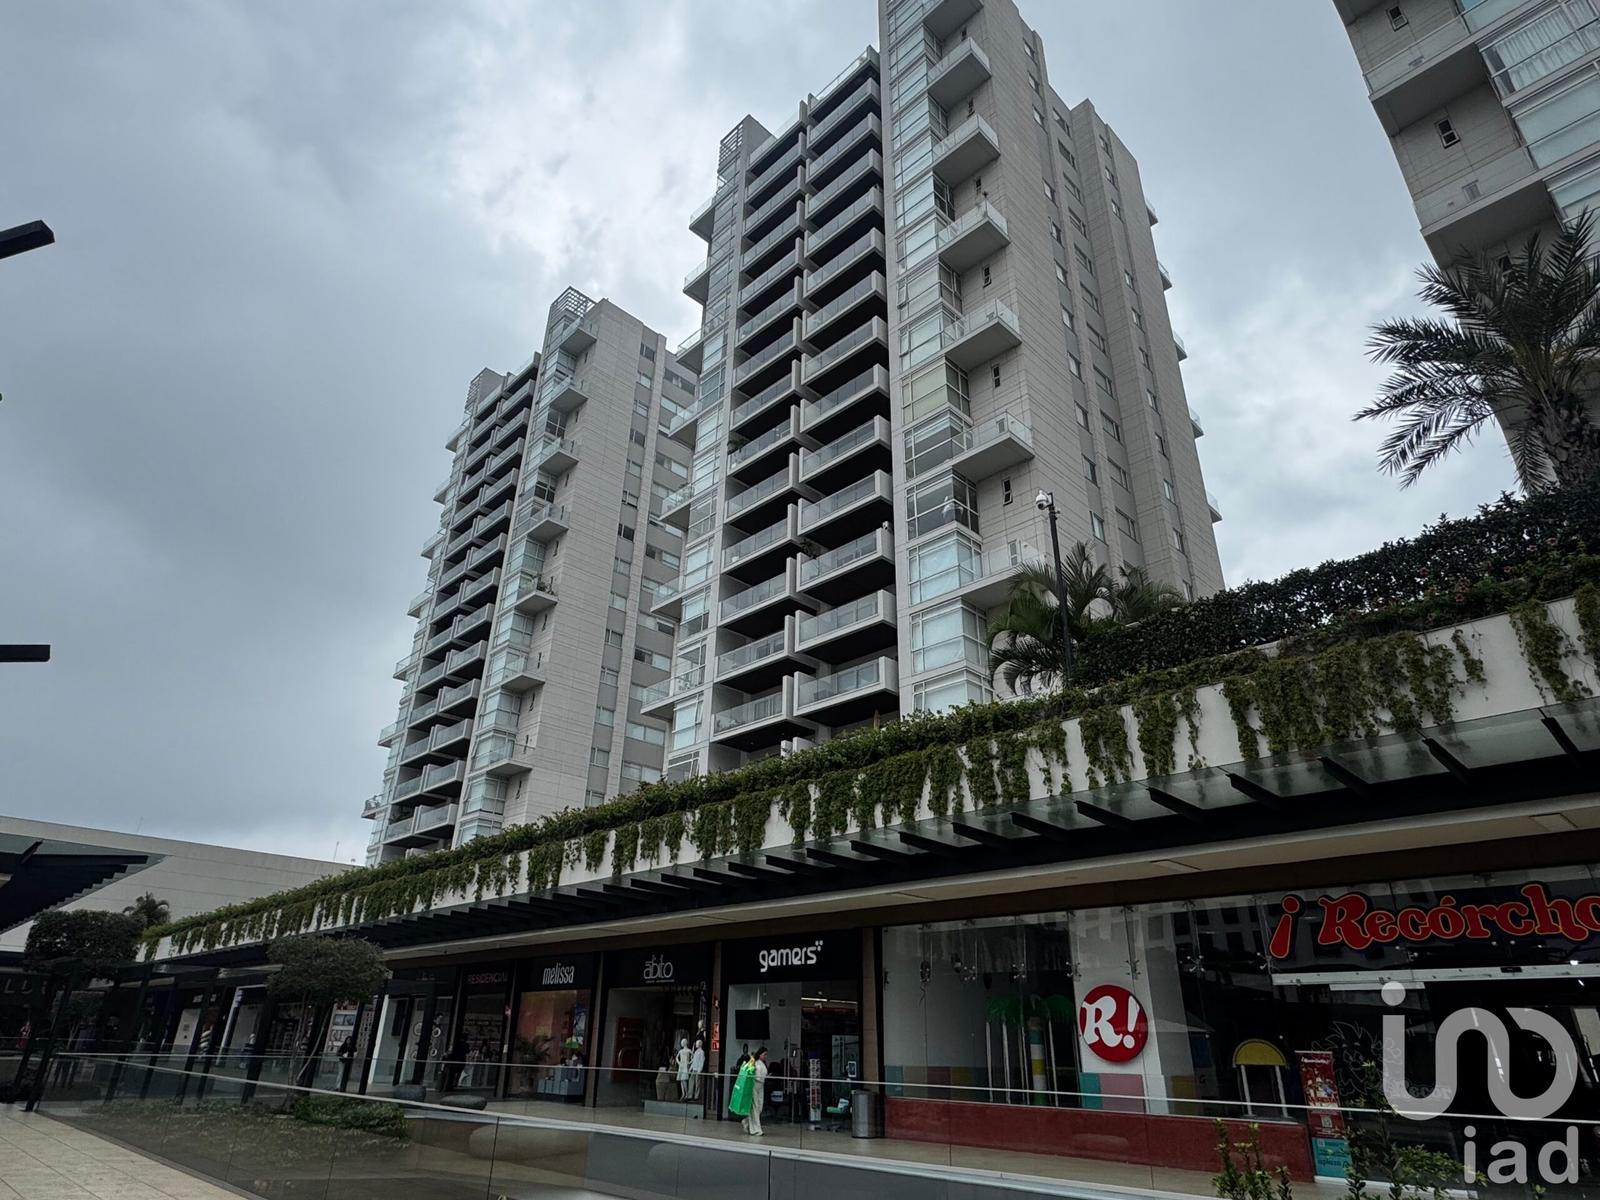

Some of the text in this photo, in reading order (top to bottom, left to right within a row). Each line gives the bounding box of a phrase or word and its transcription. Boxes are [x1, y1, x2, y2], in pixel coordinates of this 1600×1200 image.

[542, 961, 575, 985] melissa
[759, 943, 820, 973] gamers
[1081, 995, 1140, 1049] R!
